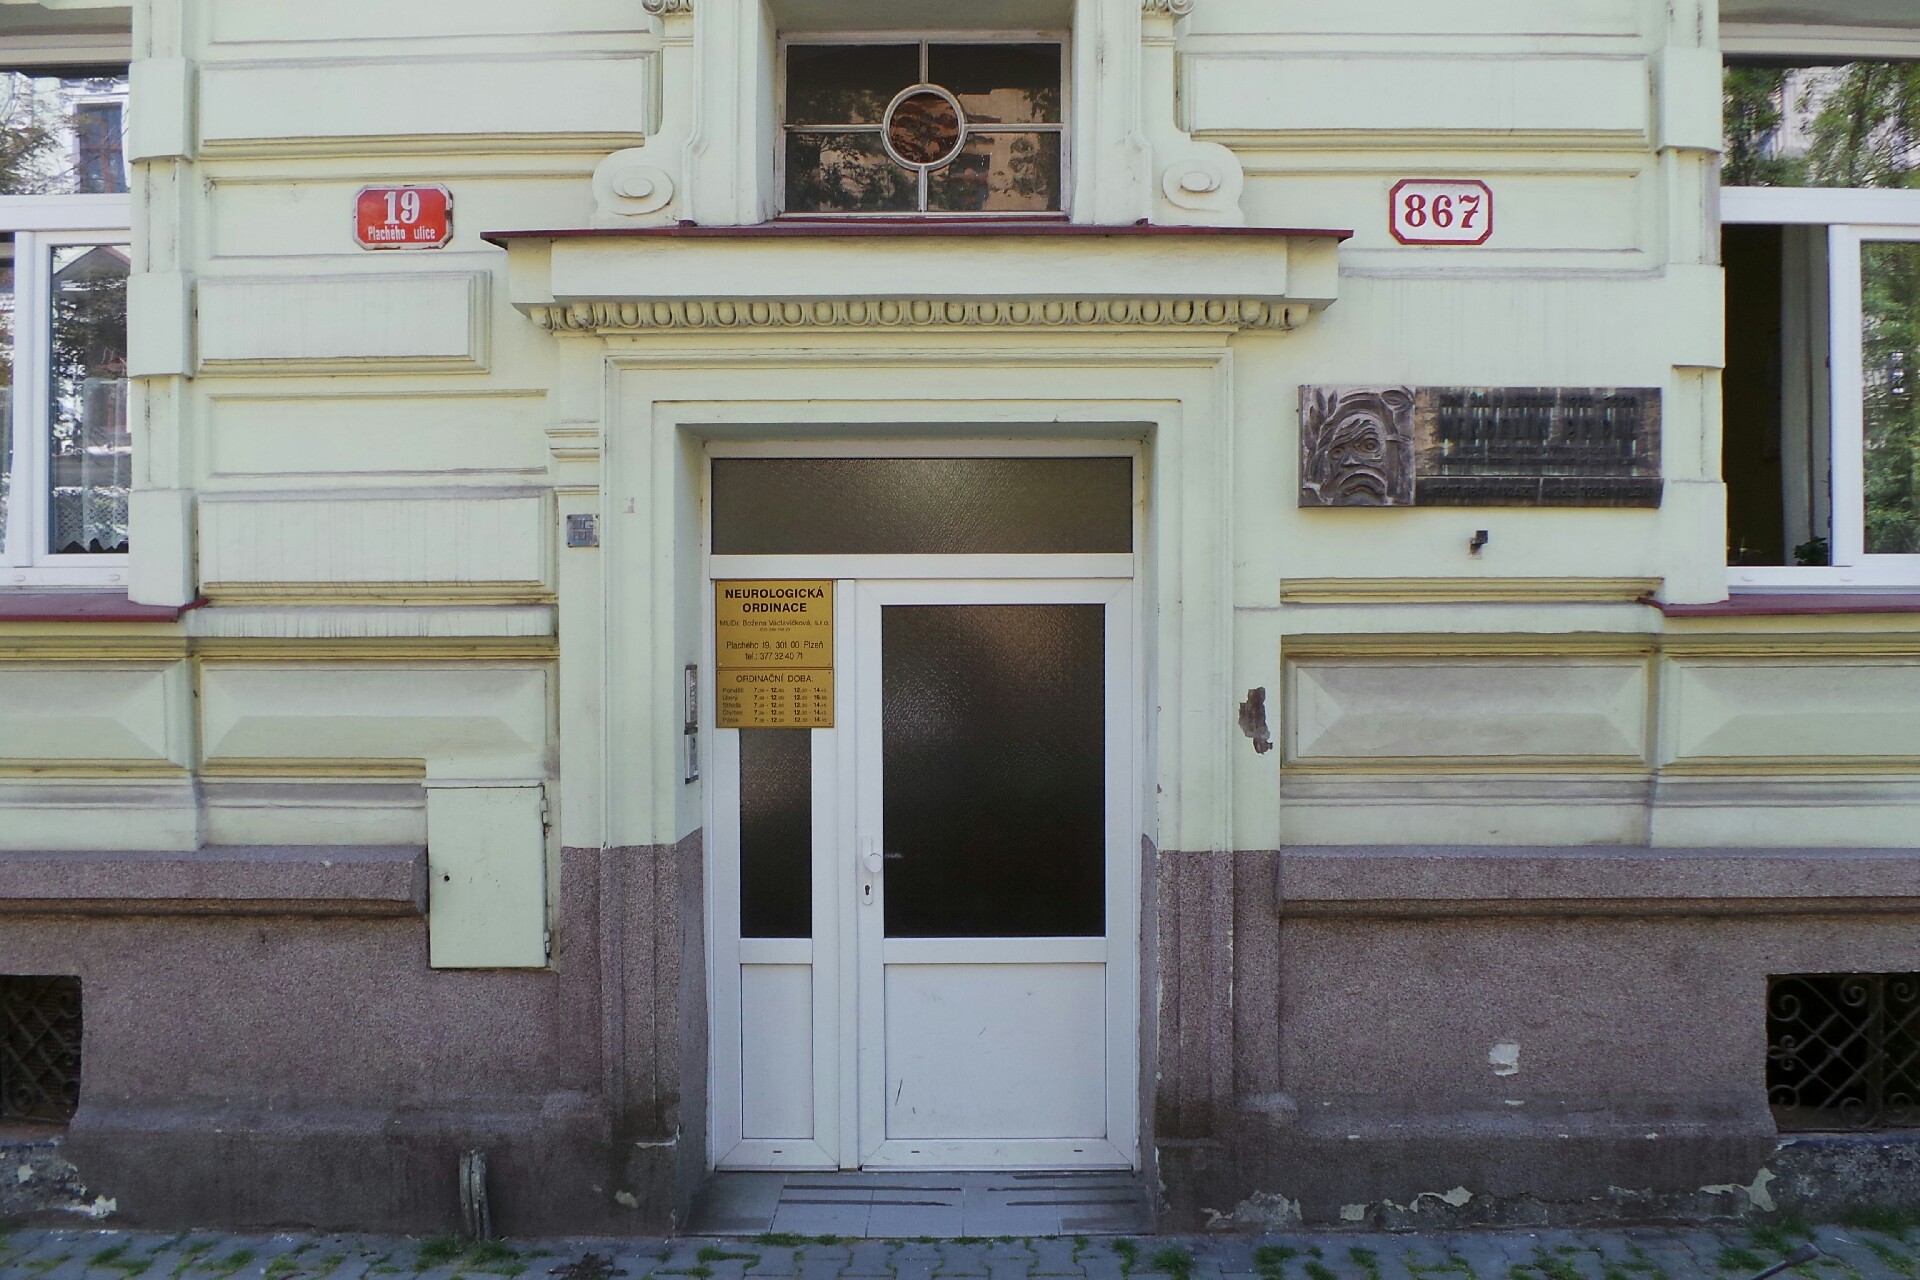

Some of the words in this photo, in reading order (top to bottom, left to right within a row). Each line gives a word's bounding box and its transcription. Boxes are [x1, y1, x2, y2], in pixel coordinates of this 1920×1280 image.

[383, 190, 420, 225] 19
[1404, 194, 1480, 228] 867
[367, 224, 406, 241] Plachého
[413, 226, 436, 241] ulice
[725, 585, 824, 599] NEUROLOGICKÁ
[742, 602, 807, 613] ORDINACE
[742, 619, 767, 627] Božena
[726, 641, 758, 650] Plachého
[775, 641, 787, 649] 301
[790, 641, 800, 649] 00
[803, 640, 824, 649] Plzeň
[759, 652, 772, 660] 377
[774, 652, 784, 660] 32
[784, 652, 794, 660] 40
[796, 652, 803, 660] 71
[736, 673, 784, 683] ORDINAČNÍ
